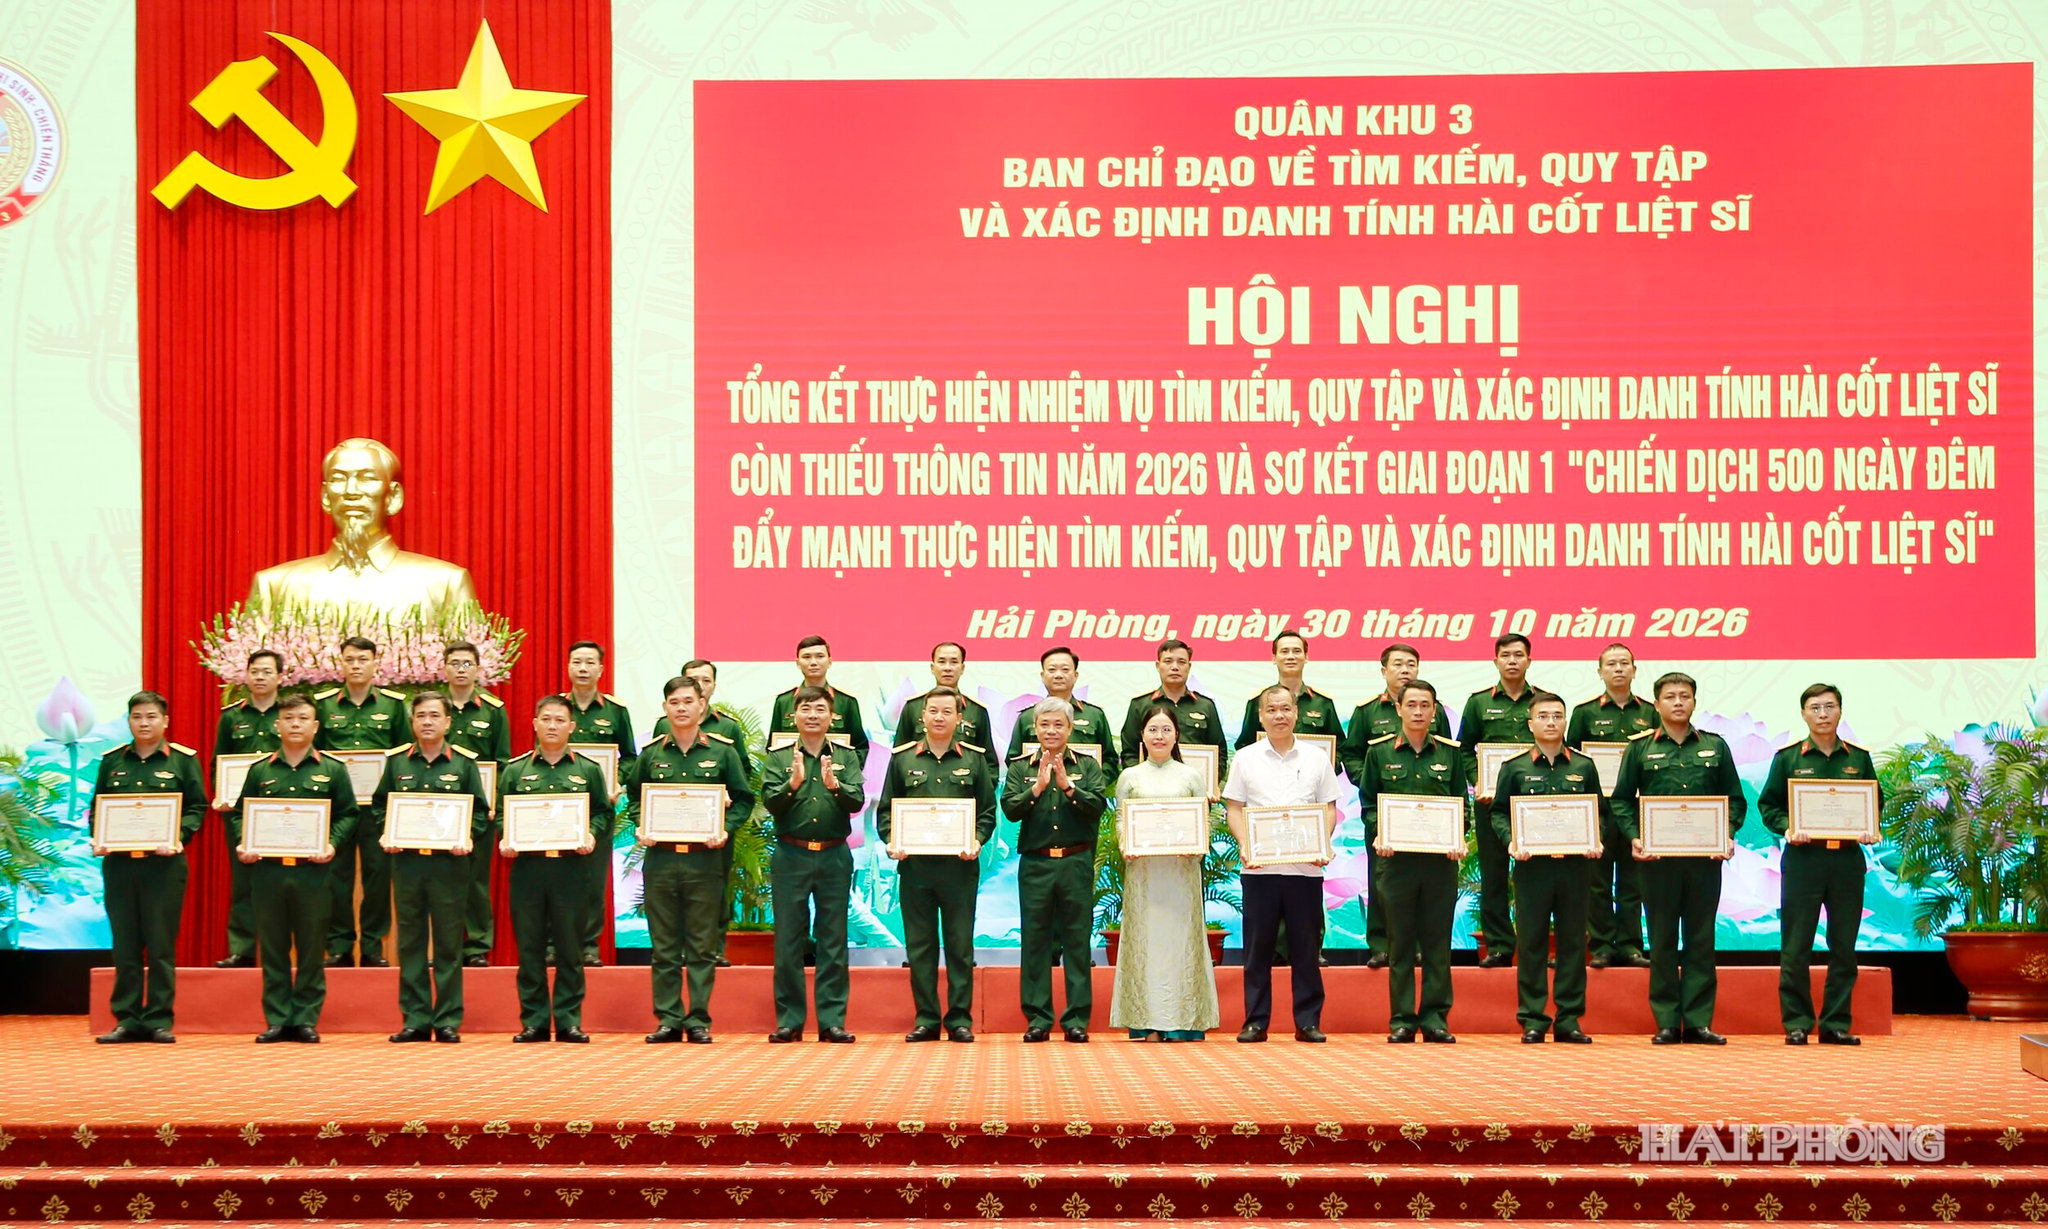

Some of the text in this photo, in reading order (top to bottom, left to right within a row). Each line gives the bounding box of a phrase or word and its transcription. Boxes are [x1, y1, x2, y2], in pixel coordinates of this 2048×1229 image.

[1235, 100, 1472, 140] QUÂN KHU 3
[1004, 143, 1707, 193] BAN CHỈ ĐẠO VỀ TÌM KIẾM, QUY TẬP
[960, 192, 1752, 243] VÀ XÁC ĐỊNH DANH TÍNH HÀI CỐT LIỆT SĨ
[1188, 274, 1518, 358] HỘI NGHỊ
[727, 358, 1998, 432] TỔNG KẾT THỰC HIỆN NHIỆM VỤ TÌM KIẾM, QUY TẬP VÀ XÁC ĐỊNH DANH TÍNH HÀI CỐT LIỆT SĨ
[731, 442, 791, 496] CÒN
[800, 437, 883, 496] THIẾU
[893, 443, 990, 495] THÔNG
[999, 453, 1047, 495] TIN
[1057, 443, 1126, 495] NĂM
[1136, 452, 1207, 495] 2026
[1216, 443, 1255, 494] VÀ
[1265, 448, 1306, 495] SƠ
[1314, 436, 1368, 494] KẾT
[1378, 451, 1436, 494] GIAI
[1446, 450, 1529, 503] ĐOẠN
[1540, 451, 1552, 493] 1
[1687, 448, 1758, 502] DỊCH
[1768, 448, 1823, 492] 500
[1834, 438, 1917, 491] NGÀY
[1926, 437, 1995, 489] ĐÊM
[733, 507, 792, 568] ĐẨY
[802, 526, 891, 578] MẠNH
[900, 521, 977, 577] THỰC
[988, 516, 1057, 577] HIỆN
[1067, 515, 1121, 567] TÌM
[1132, 509, 1217, 573] KIẾM,
[1228, 524, 1286, 572] QUY
[1295, 515, 1352, 577] TẬP
[1362, 515, 1401, 567] VÀ
[1410, 514, 1471, 567] XÁC
[1481, 524, 1555, 576] ĐỊNH
[1566, 523, 1649, 566] DANH
[1659, 513, 1730, 566] TÍNH
[1741, 512, 1791, 565] HÀI
[1803, 505, 1861, 565] CỐT
[1872, 511, 1935, 574] LIỆT
[966, 606, 1749, 641] Hải Phòng, ngày 30 tháng 10 năm 2026
